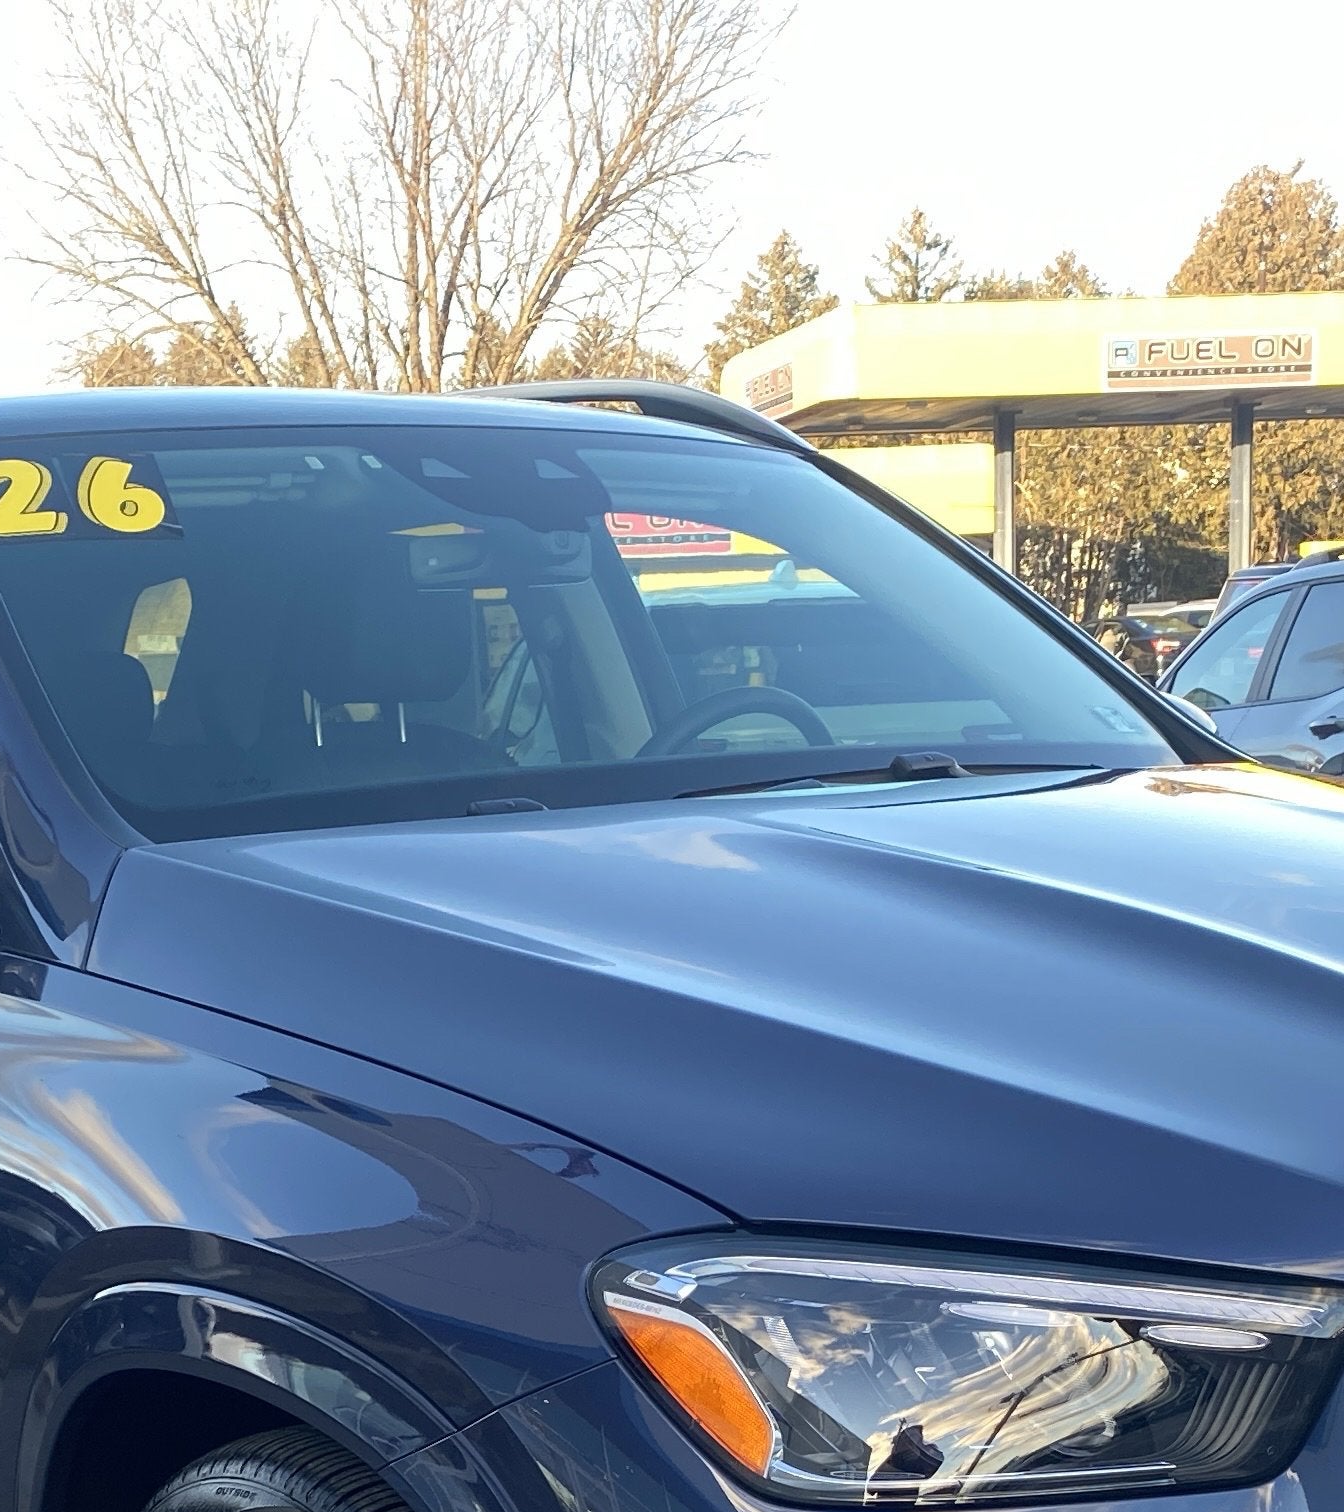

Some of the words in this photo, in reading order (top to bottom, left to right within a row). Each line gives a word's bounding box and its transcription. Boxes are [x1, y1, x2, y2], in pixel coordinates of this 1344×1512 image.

[1148, 340, 1236, 362] FUEL
[1255, 337, 1302, 358] ON
[1120, 368, 1236, 377] CONVENIENCE
[1246, 365, 1296, 373] STORE
[216, 1486, 258, 1501] OUTSIDE
